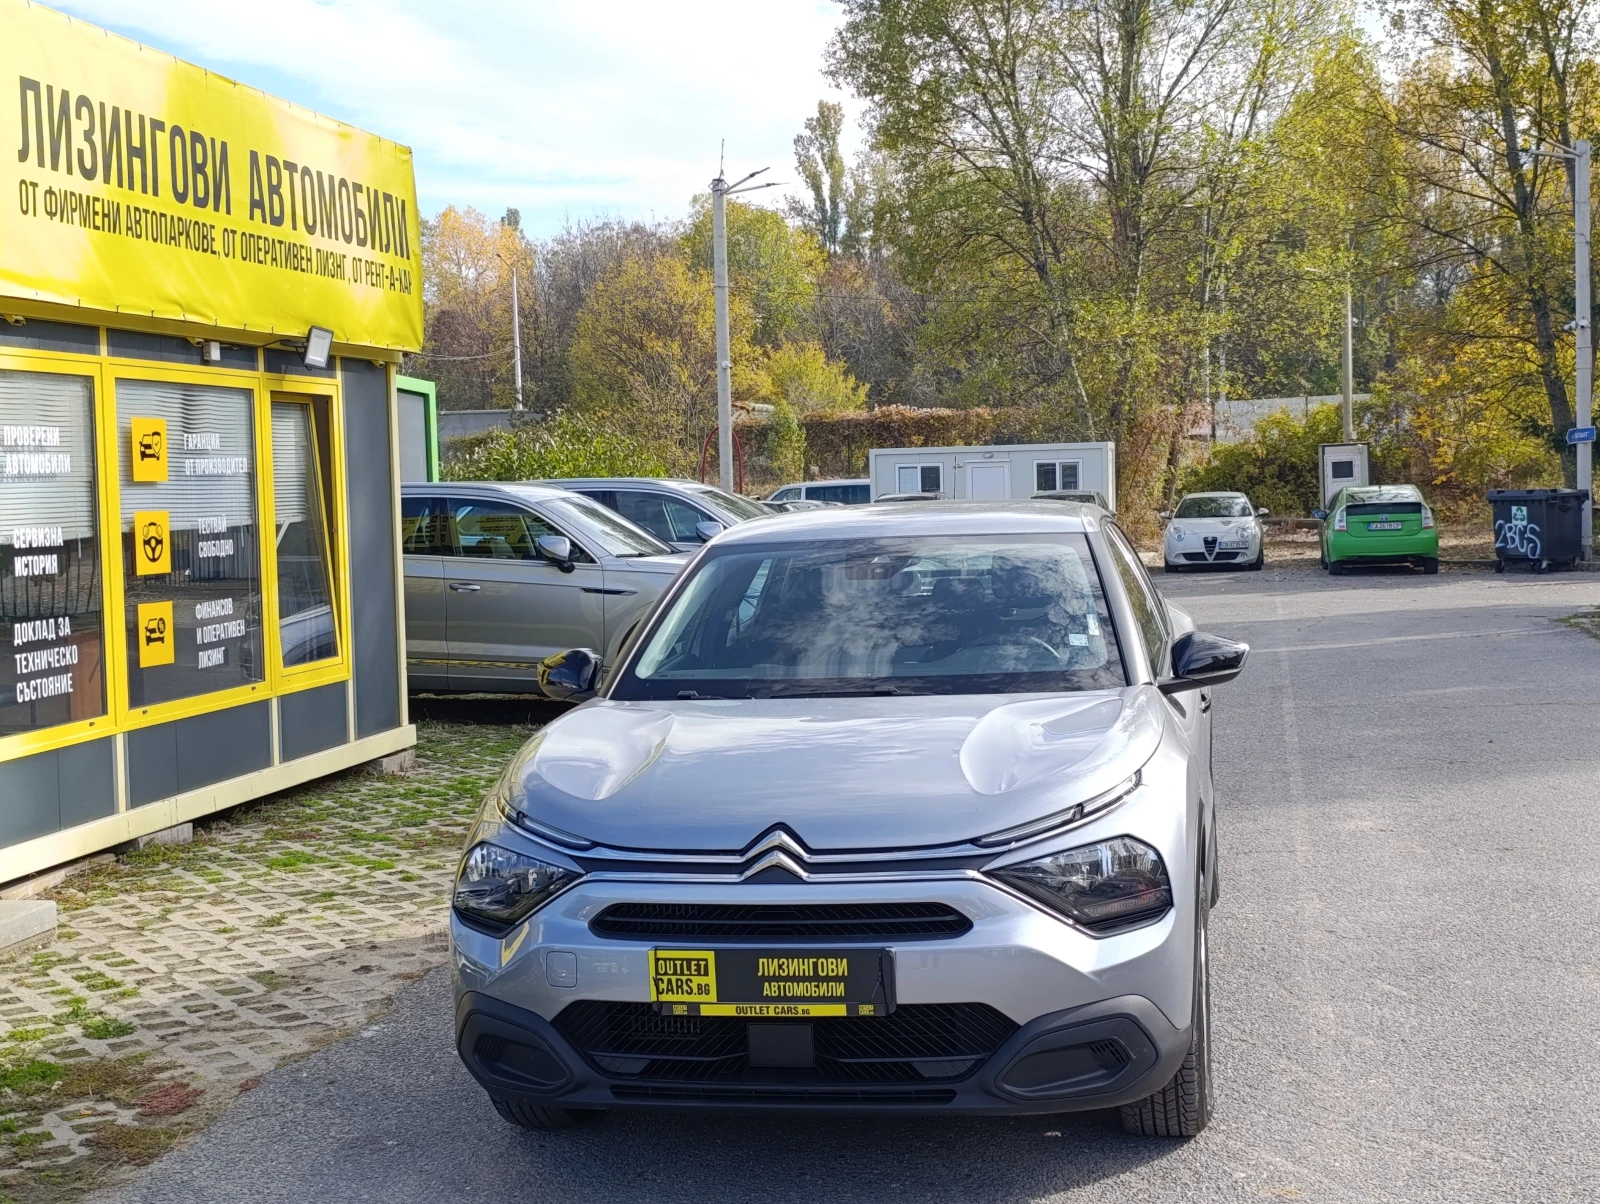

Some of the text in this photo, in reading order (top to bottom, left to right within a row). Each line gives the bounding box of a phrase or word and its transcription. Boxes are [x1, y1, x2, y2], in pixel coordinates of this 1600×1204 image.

[18, 75, 410, 260] ЛИЗИНГОВИ АВТОМОБИЛИ
[19, 179, 38, 217] ОТ
[44, 186, 122, 235] ФИРМЕНИ
[125, 204, 220, 260] АВТОПАРКОВЕ,
[222, 228, 237, 259] ОТ
[241, 232, 313, 275] ОПЕРАТИВЕН
[352, 256, 362, 284] ОТ
[365, 259, 412, 295] РЕНТ-А-КАР
[3, 425, 60, 446] ПРОВЕРЕНИ
[184, 433, 220, 451] ГАРАНЦИЯ
[6, 454, 71, 474] АВТОМОБИЛИ
[185, 457, 247, 475] ОТ ПРОИЗВОДИТЕЛ
[198, 513, 227, 535] ТЕСТВАЙ
[13, 526, 64, 549] СЕРВИЗНА
[198, 538, 234, 558] СВОБОДНО
[14, 553, 58, 577] ИСТОРИЯ
[195, 597, 233, 620] ФИНАНСОВ
[13, 616, 71, 647] ДОКЛАД ЗА
[196, 619, 246, 645] И ОПЕРАТИВЕН
[15, 645, 78, 675] ТЕХНИЧЕСКО
[198, 646, 226, 669] ЛИЗИНГ
[16, 672, 73, 703] СЪСТОЯНИЕ
[657, 959, 707, 975] OUTLET
[757, 958, 848, 976] ЛИЗИНГОВИ
[656, 977, 711, 996] CARS.BG
[763, 981, 845, 997] АВТОМОБИЛИ
[735, 1006, 810, 1015] OUTLET CARS.BG
